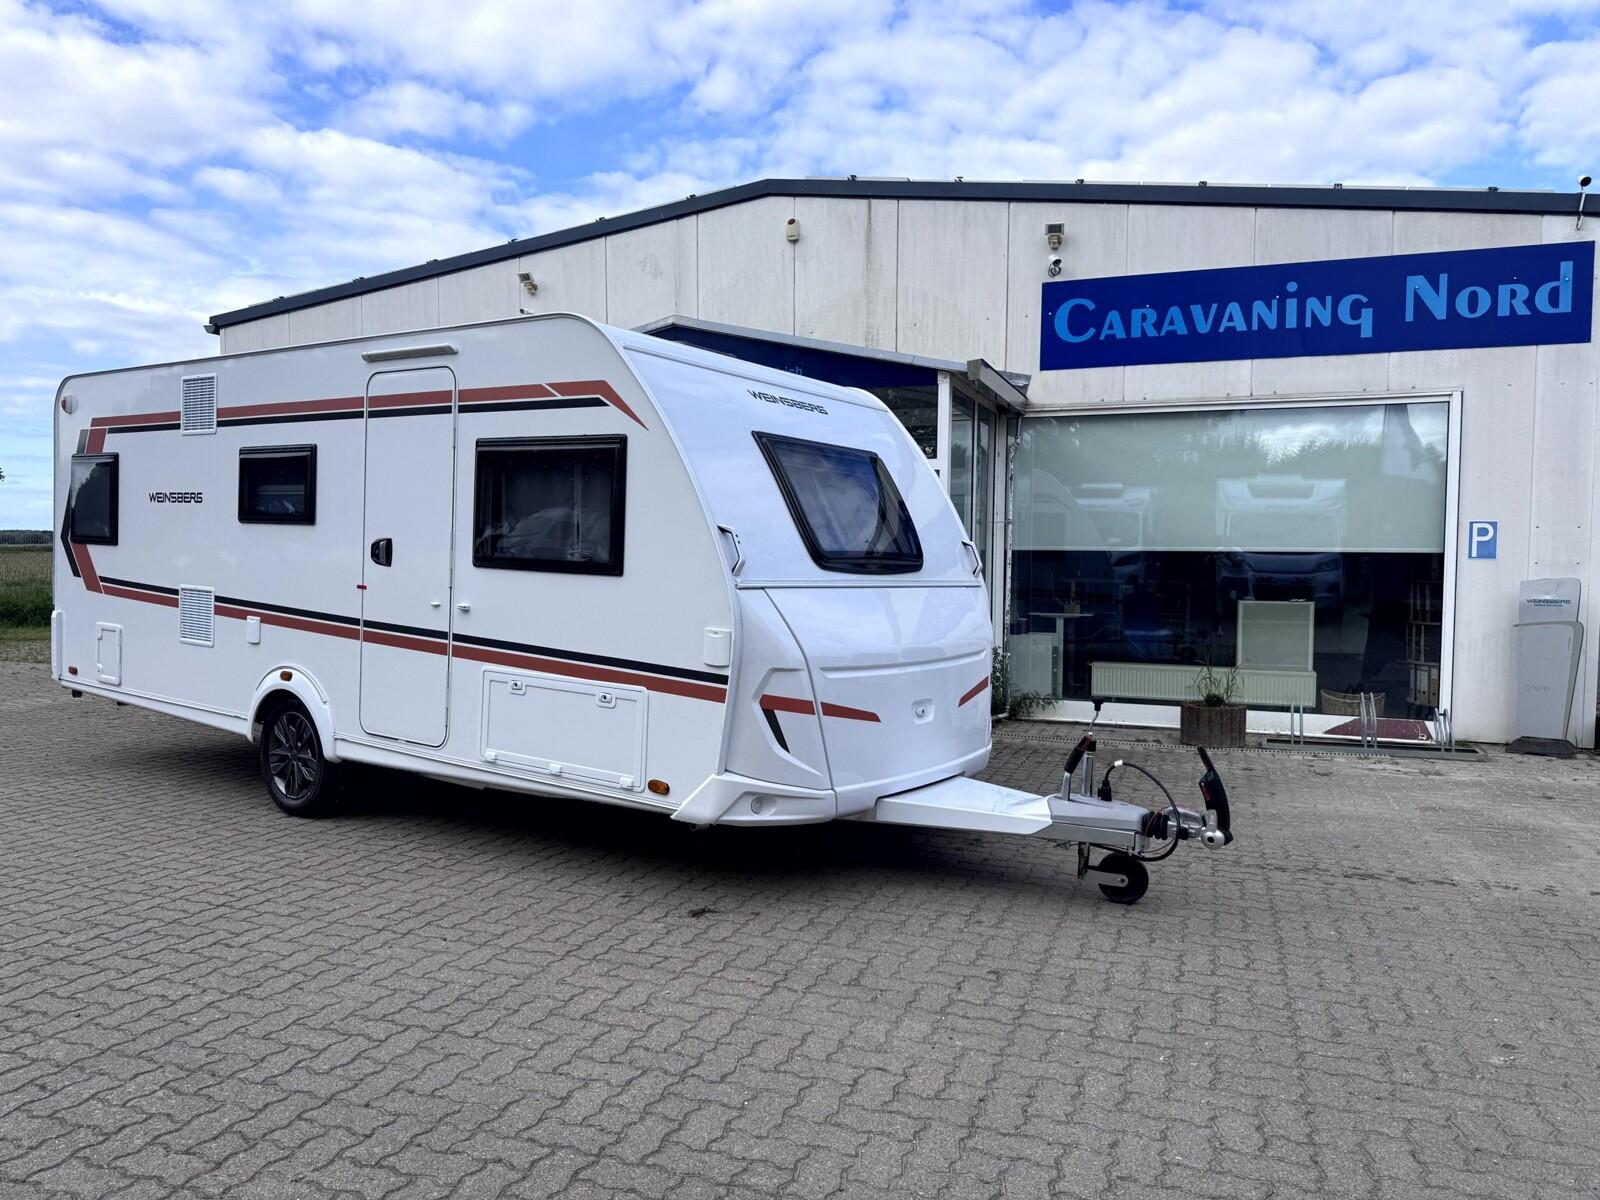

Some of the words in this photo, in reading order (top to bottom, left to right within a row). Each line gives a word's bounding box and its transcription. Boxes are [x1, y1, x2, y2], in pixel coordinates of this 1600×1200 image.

[746, 389, 829, 415] WEINSBERG
[148, 491, 203, 504] WEINSBERG
[1471, 522, 1494, 558] P
